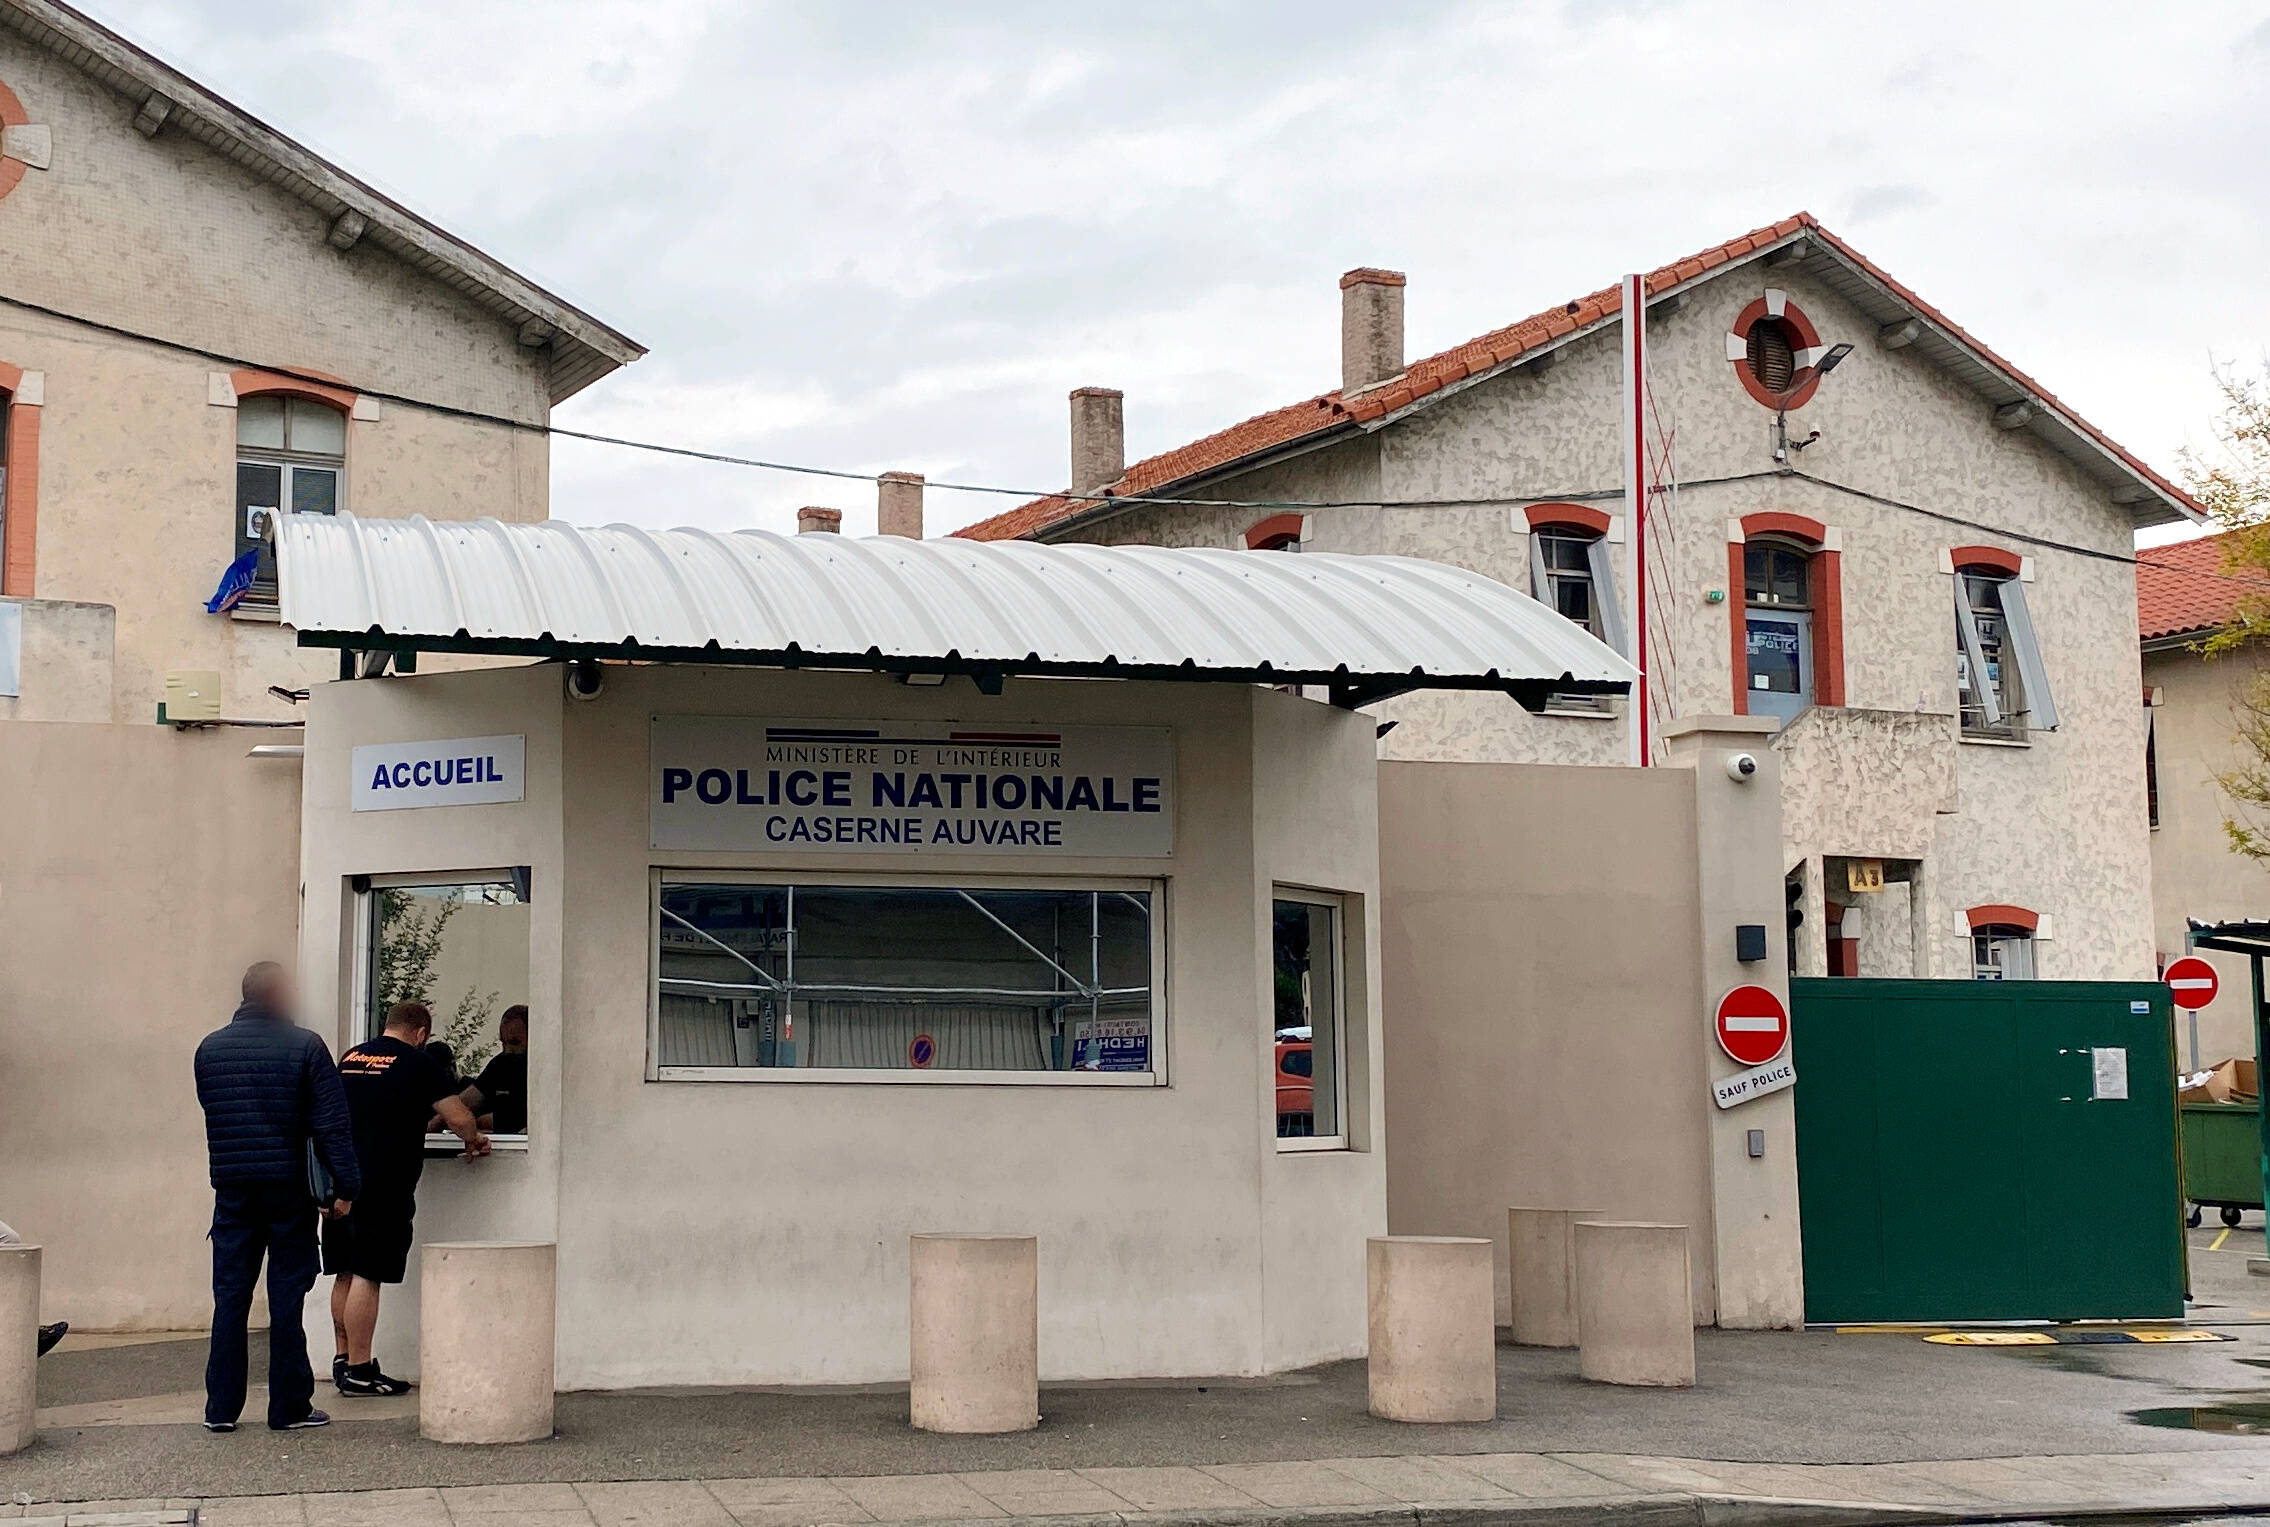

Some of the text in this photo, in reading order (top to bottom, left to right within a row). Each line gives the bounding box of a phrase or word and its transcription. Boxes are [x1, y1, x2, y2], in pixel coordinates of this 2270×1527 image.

[371, 756, 503, 790] ACCUEIL
[765, 745, 1061, 769] MINISTÈRE DE L'INTÉRIEUR
[662, 768, 1161, 813] POLICE NATIONALE
[765, 816, 1062, 846] CASERNE AUVARE
[1719, 1066, 1791, 1100] SAUF POLICE
